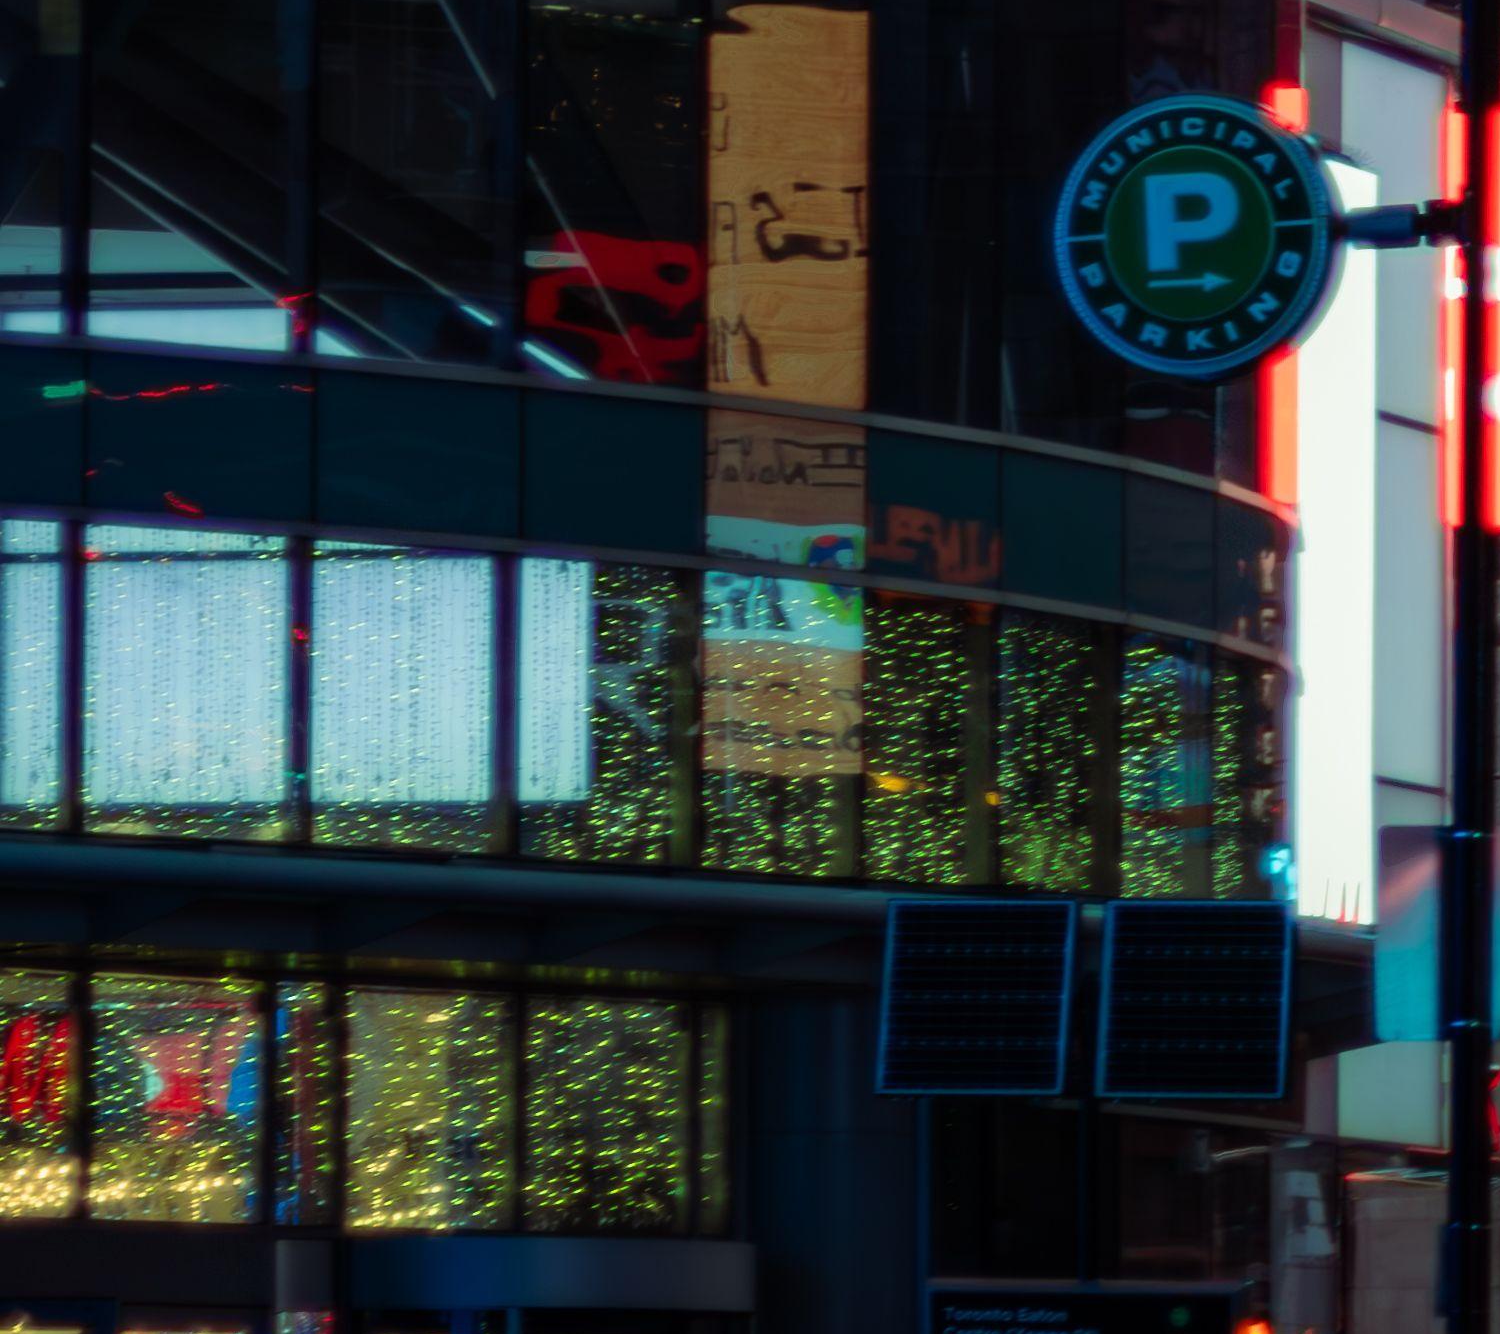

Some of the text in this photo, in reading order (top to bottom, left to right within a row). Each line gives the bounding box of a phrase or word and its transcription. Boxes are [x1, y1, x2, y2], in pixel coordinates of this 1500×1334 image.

[1080, 116, 1292, 211] MUNICIPAL
[1145, 172, 1240, 273] P
[1080, 249, 1302, 353] PARKING
[944, 1307, 1013, 1321] Toronto
